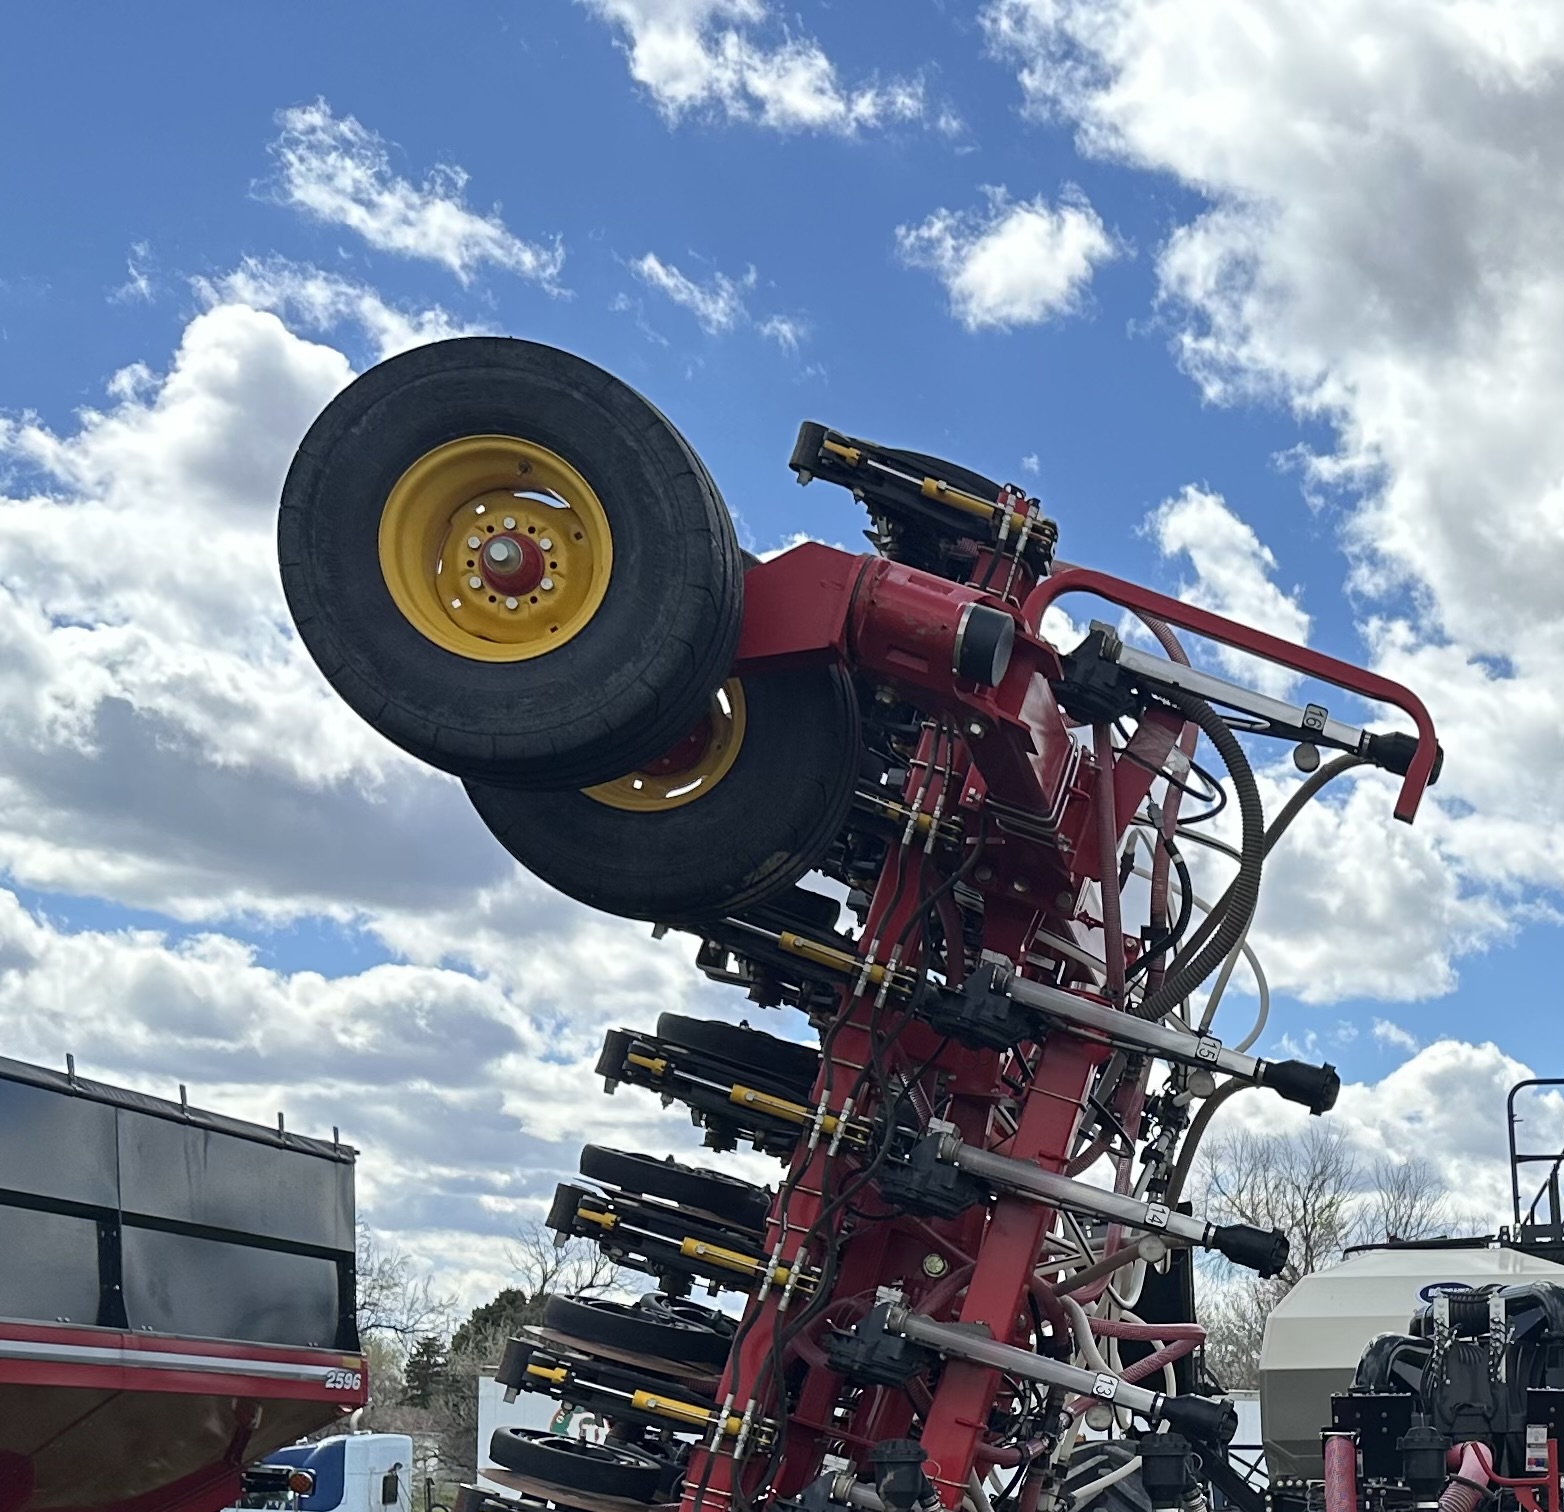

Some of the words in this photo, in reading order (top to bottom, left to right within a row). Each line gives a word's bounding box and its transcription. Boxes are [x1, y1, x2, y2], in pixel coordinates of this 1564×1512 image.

[1306, 710, 1323, 729] 16
[1199, 1041, 1218, 1059] 15
[1148, 1208, 1165, 1225] 14
[325, 1370, 362, 1391] 2596
[1095, 1379, 1112, 1397] 13
